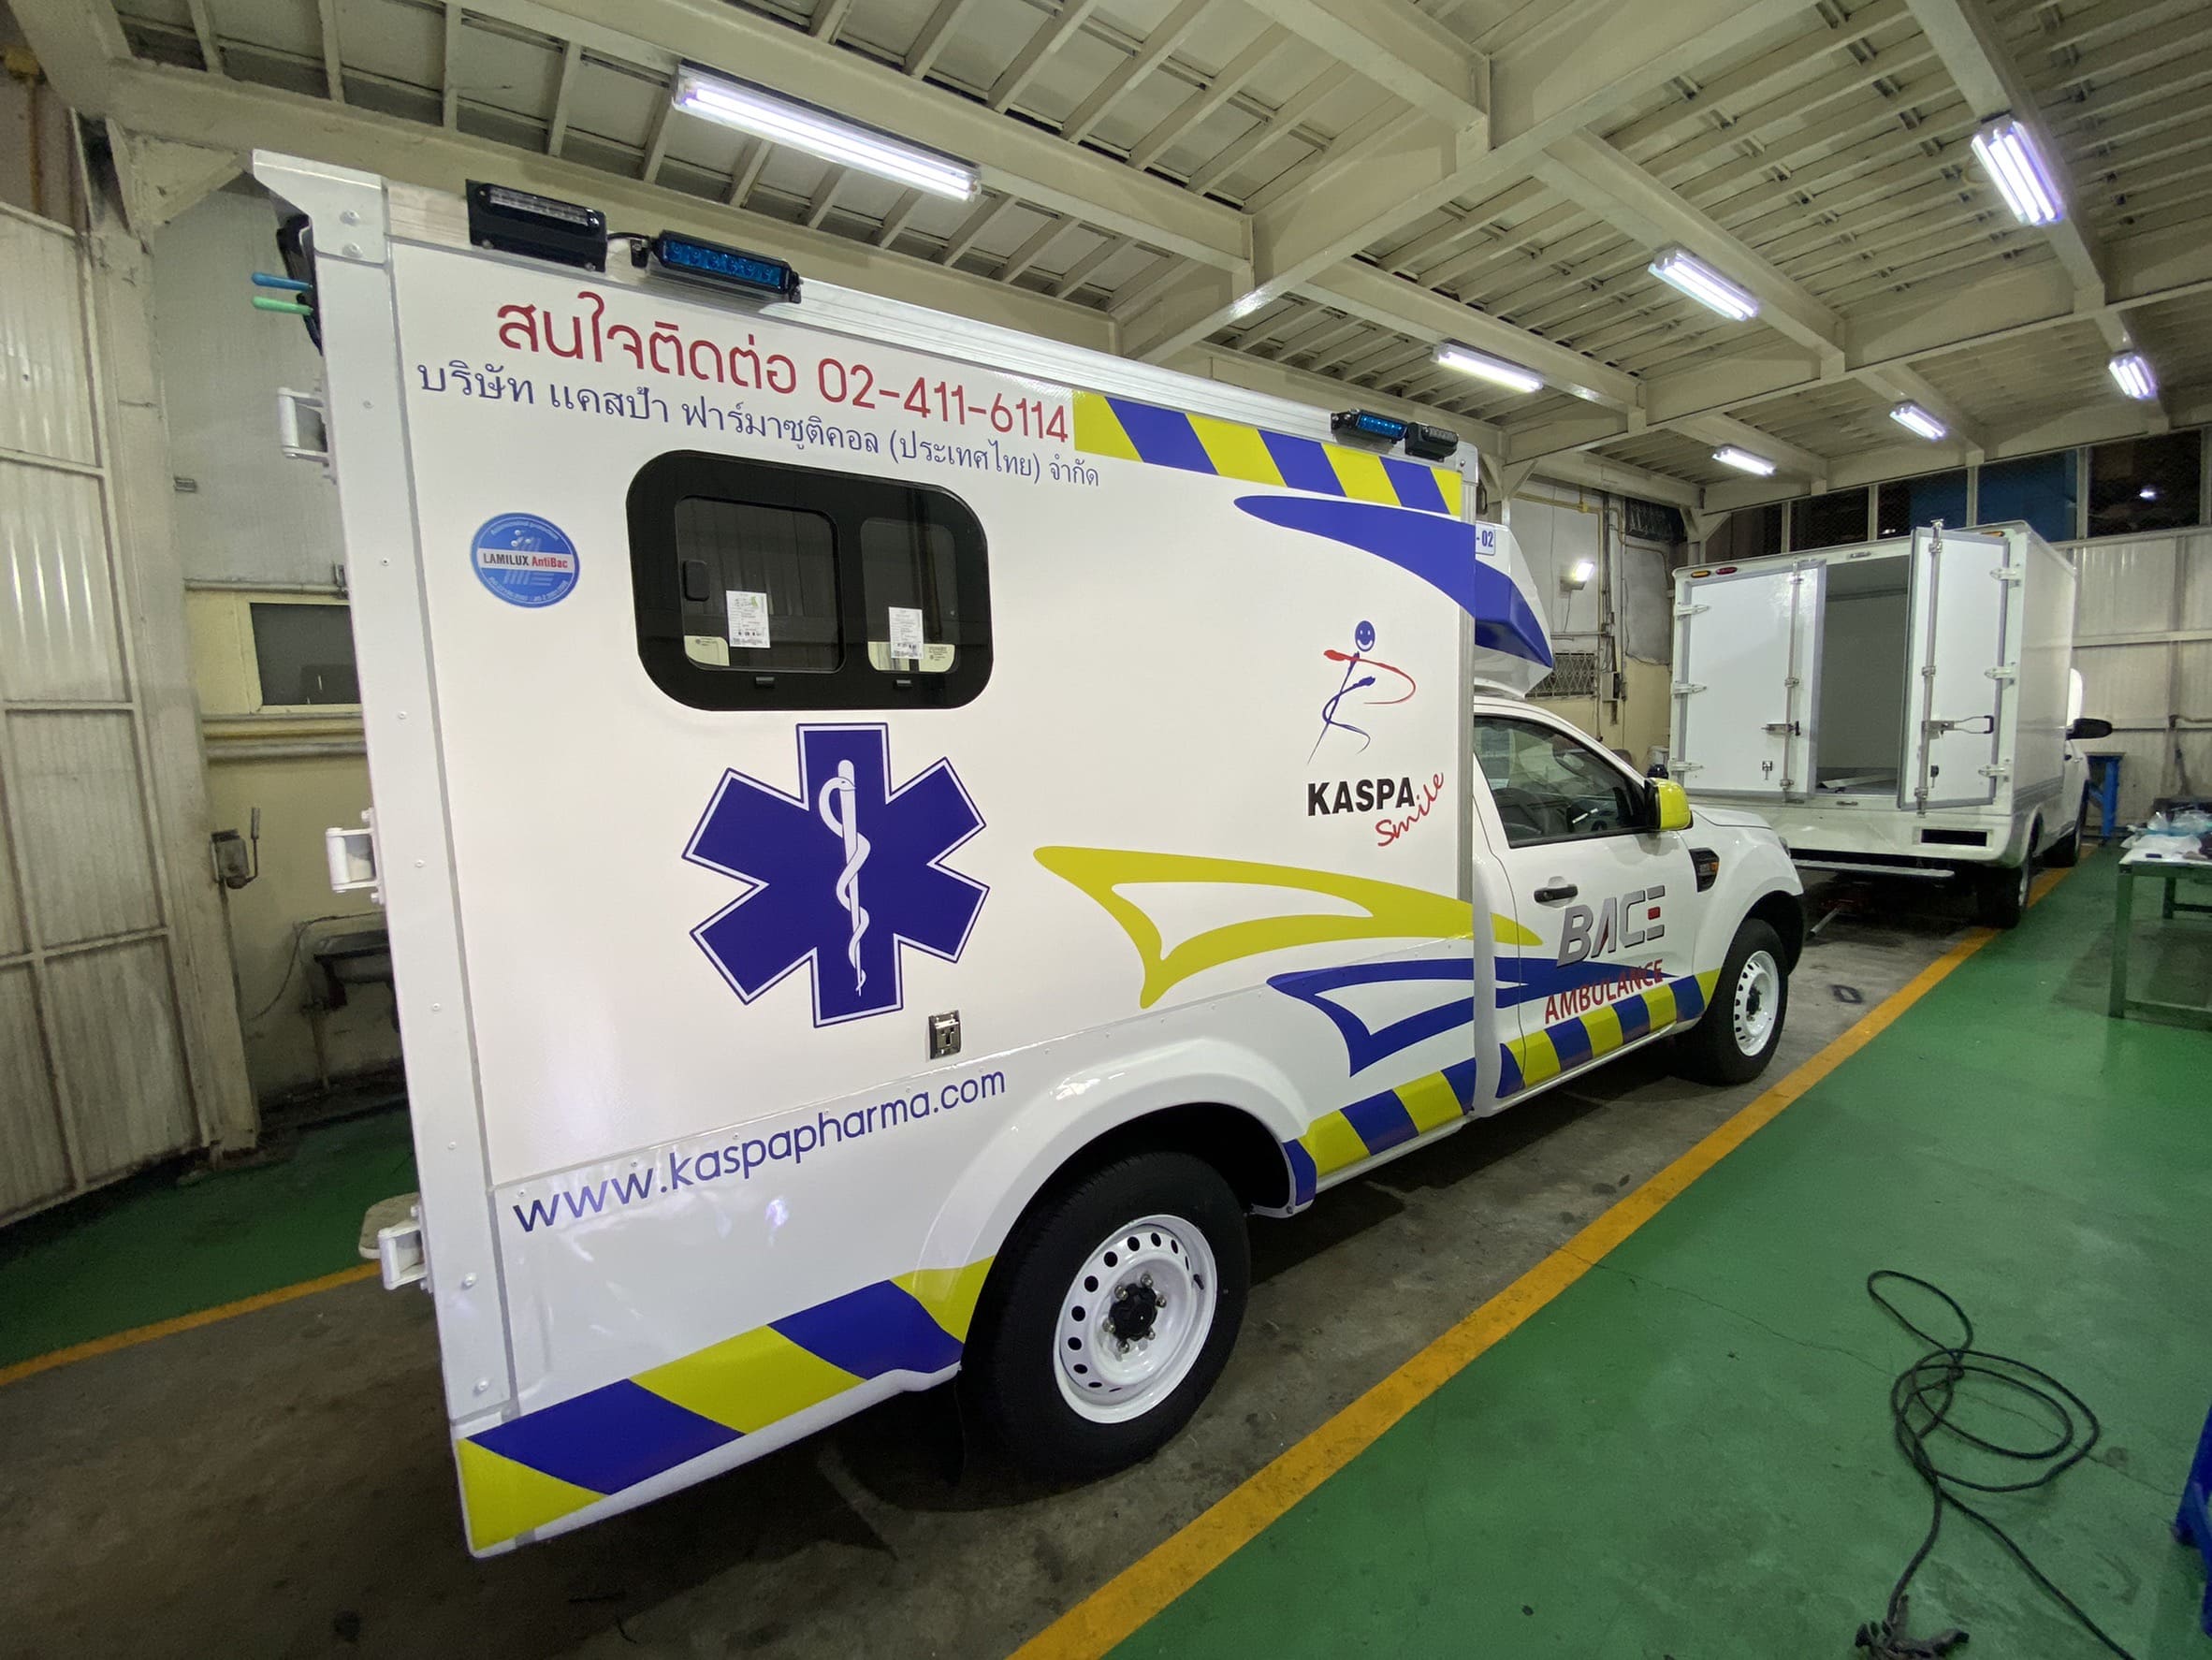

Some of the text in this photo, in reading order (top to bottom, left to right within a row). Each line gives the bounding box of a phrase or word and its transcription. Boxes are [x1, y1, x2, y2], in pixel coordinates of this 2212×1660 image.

[497, 291, 1069, 443] สนใจติดต่อ 02-411-6114
[417, 359, 1099, 487] บริษัท แคสป้า ฟาร์มาซูติคอล (ประเทศไทย) จำกัด
[483, 553, 568, 568] LAMILUX AntiBac
[1307, 777, 1416, 817] KASPA
[1375, 771, 1445, 847] Smile
[1545, 958, 1665, 1025] AMBULANCE
[512, 1070, 1006, 1232] www.kaspapharma.com
